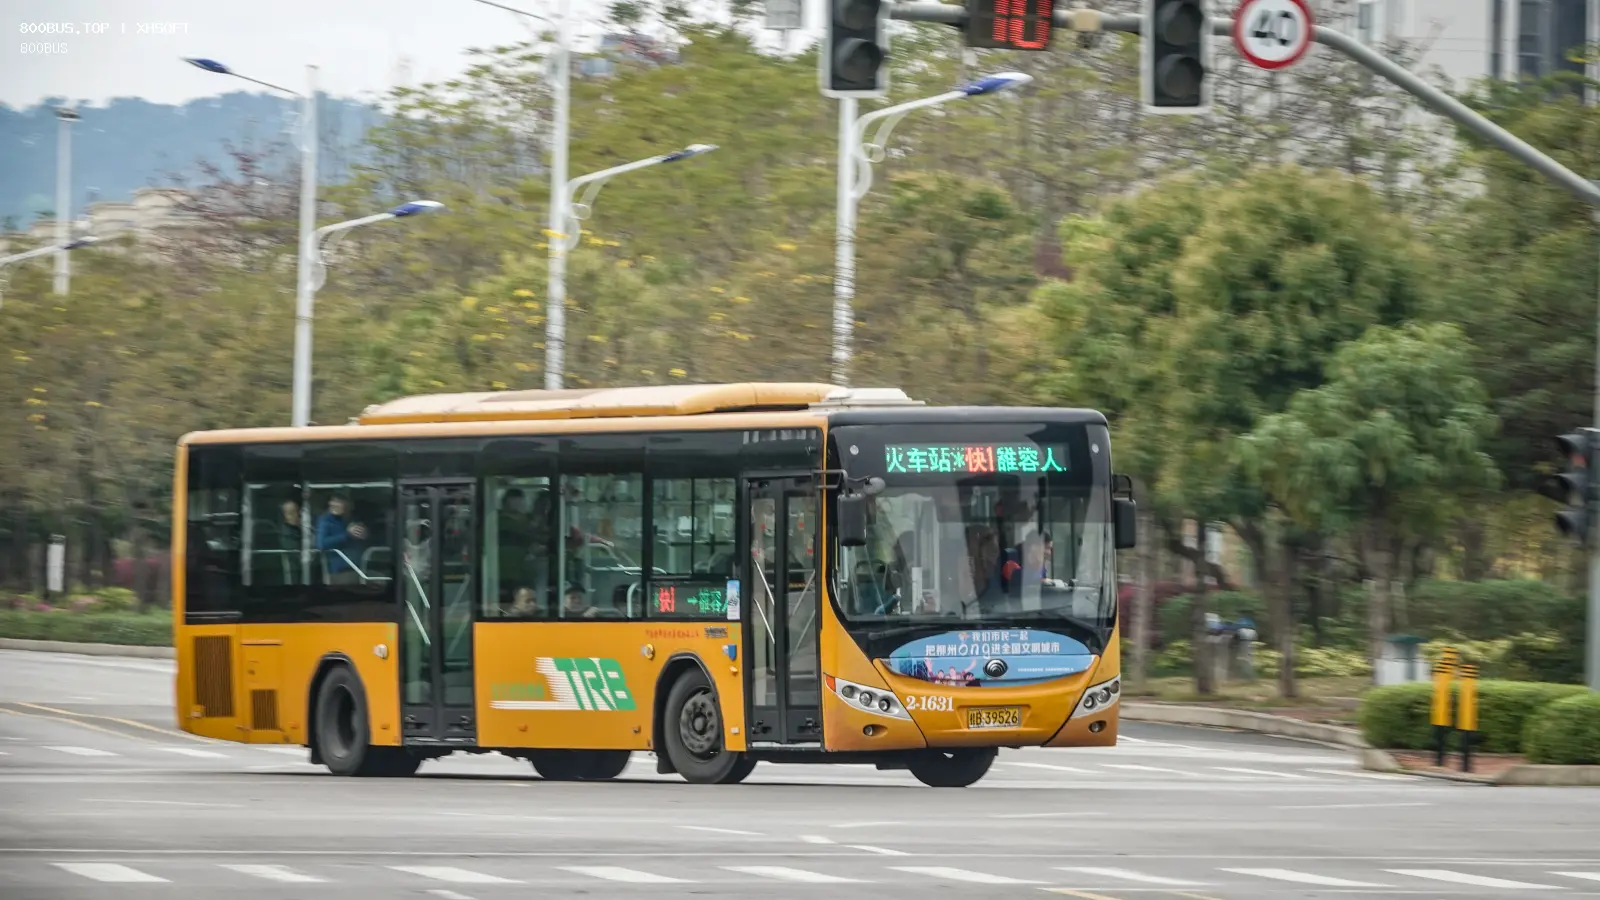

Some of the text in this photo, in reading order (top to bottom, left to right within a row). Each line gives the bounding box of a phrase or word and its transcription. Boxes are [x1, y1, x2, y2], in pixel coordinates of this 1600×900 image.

[1254, 9, 1297, 47] 40
[972, 631, 1029, 642] 我们市民一起
[552, 657, 637, 711] TRB
[906, 695, 954, 712] 2-1631
